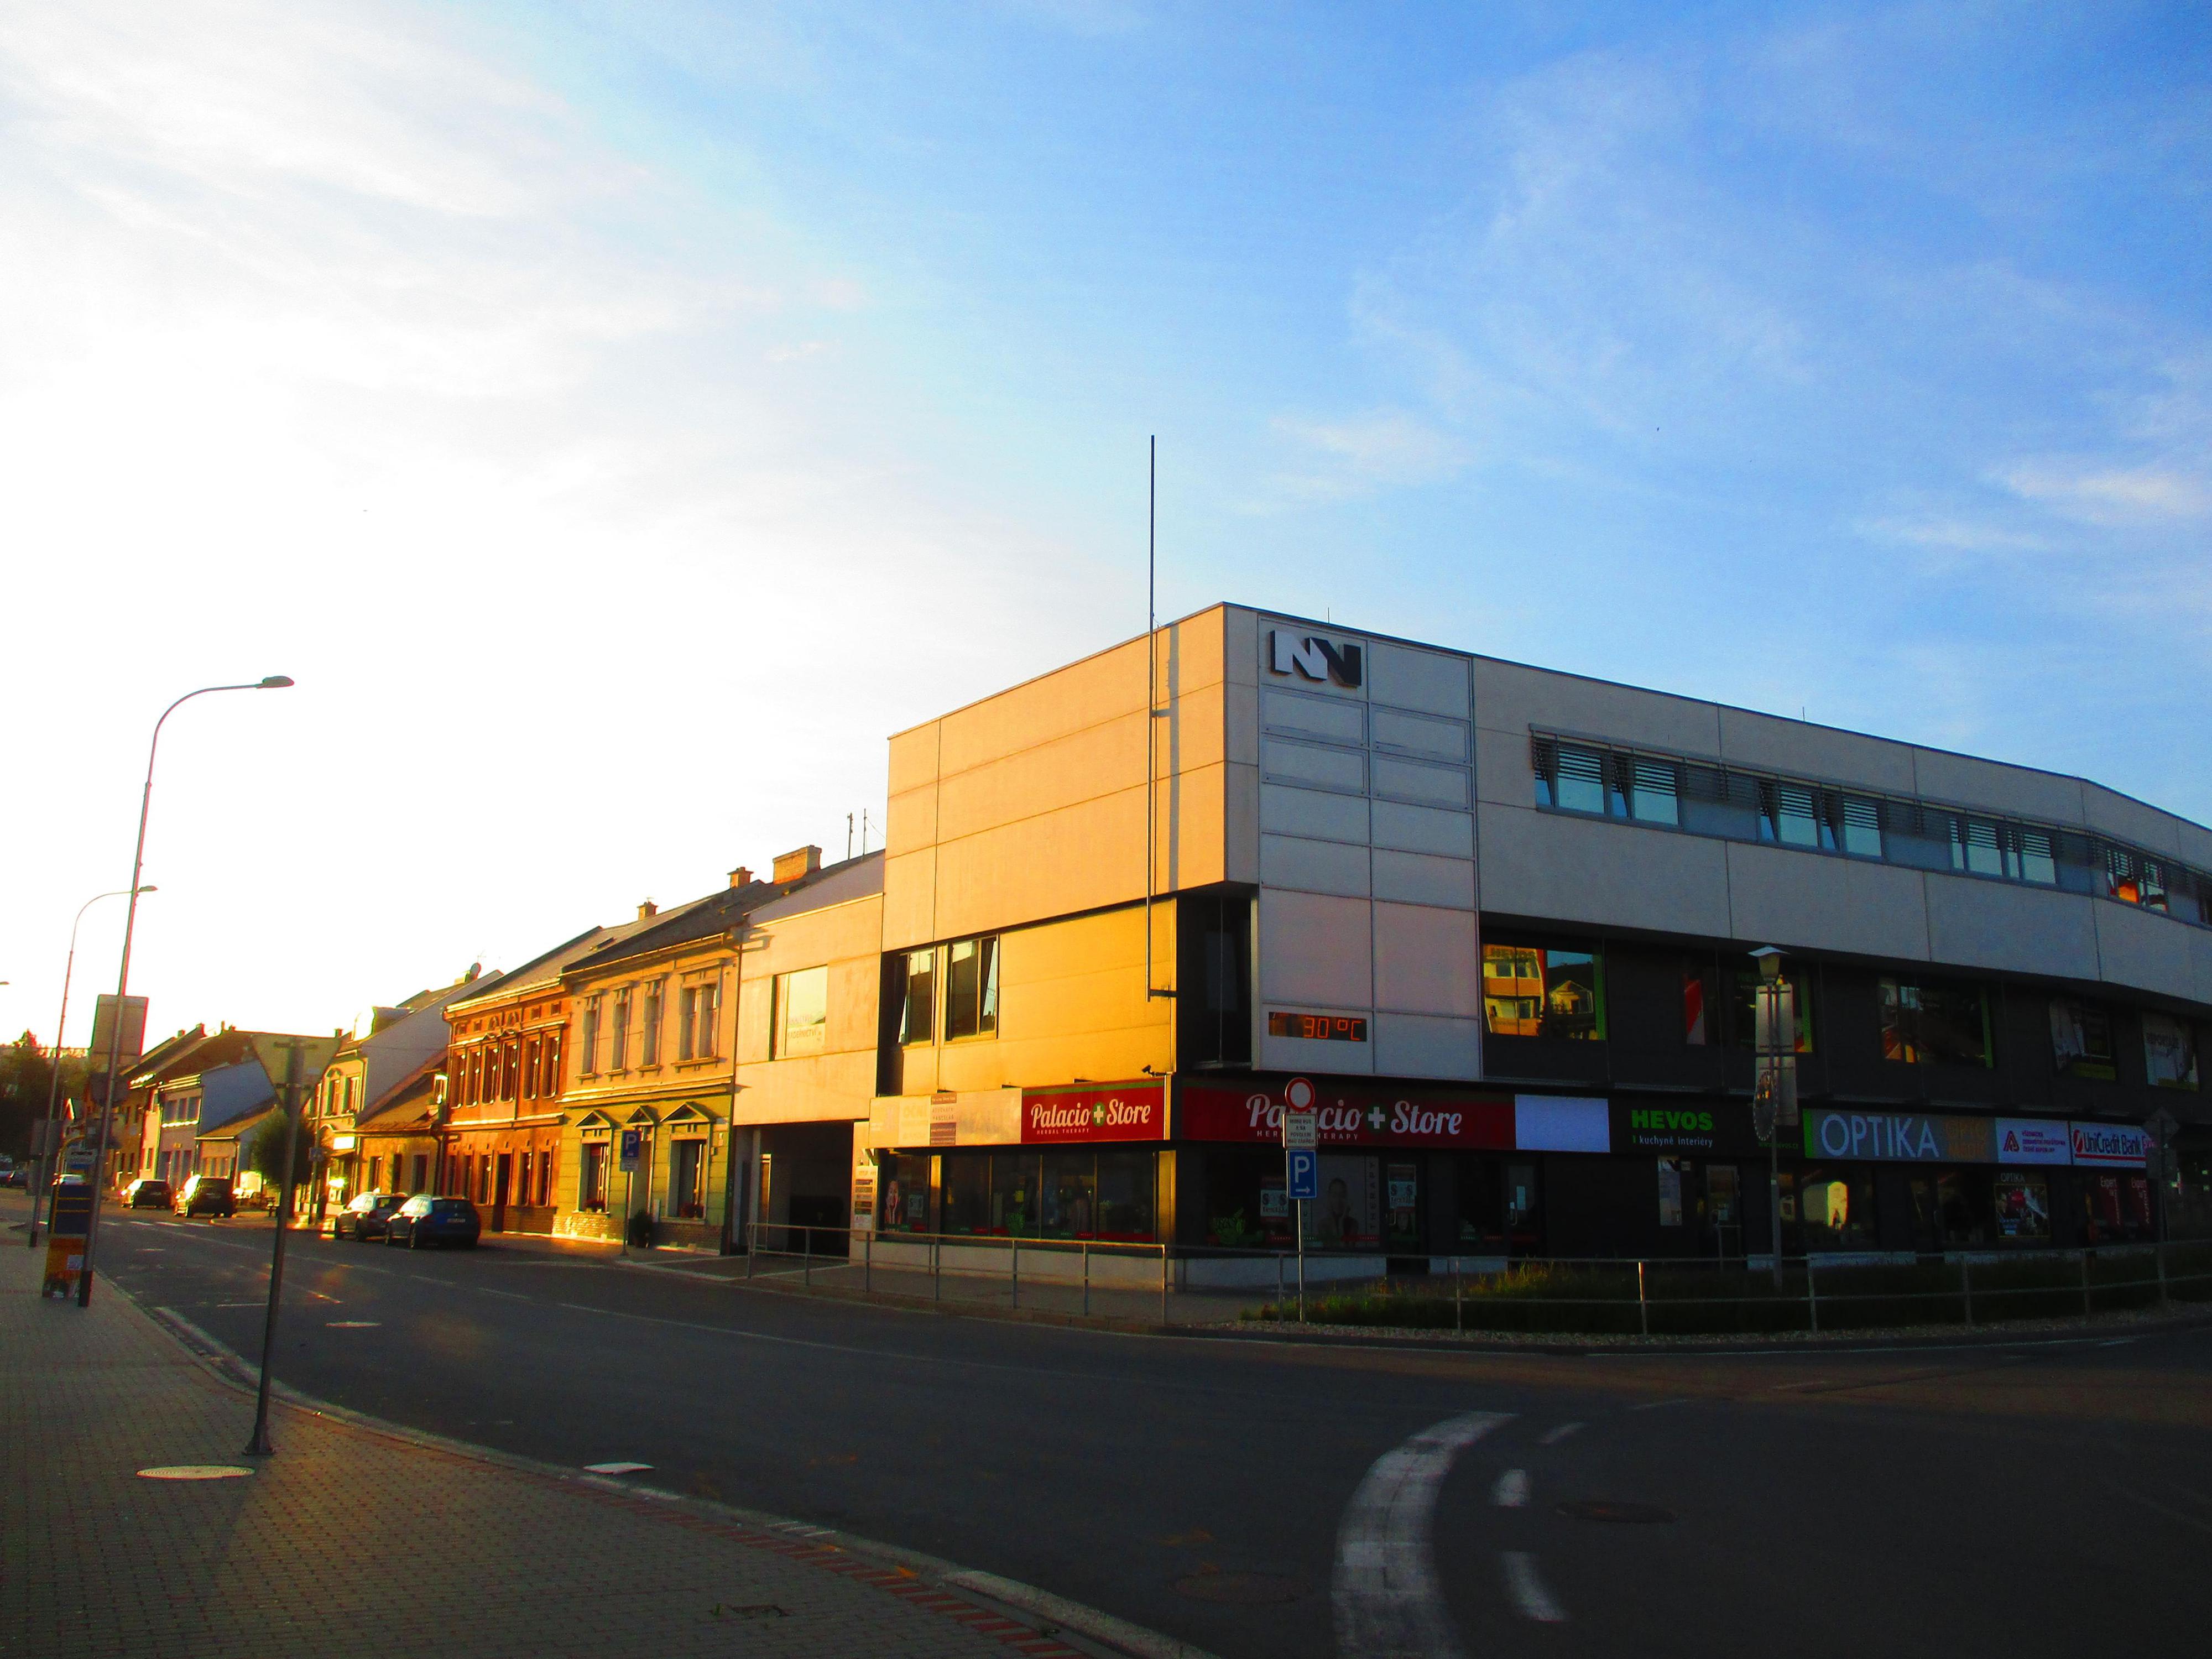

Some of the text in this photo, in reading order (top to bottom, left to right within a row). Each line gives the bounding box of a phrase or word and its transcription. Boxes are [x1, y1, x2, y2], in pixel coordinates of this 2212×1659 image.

[1031, 1103, 1091, 1129] Palacio
[1107, 1098, 1151, 1126] Store
[1246, 1093, 1463, 1135] Pacio Store
[1631, 1110, 1714, 1131] HEVOS
[626, 1134, 637, 1150] P
[1317, 1132, 1359, 1141] HERAPY
[1820, 1114, 1940, 1157] OPTIKA
[2083, 1132, 2120, 1154] UniCredit
[2122, 1134, 2141, 1155] Bank
[1294, 1155, 1310, 1184] P
[2000, 1172, 2026, 1182] OPTIKA
